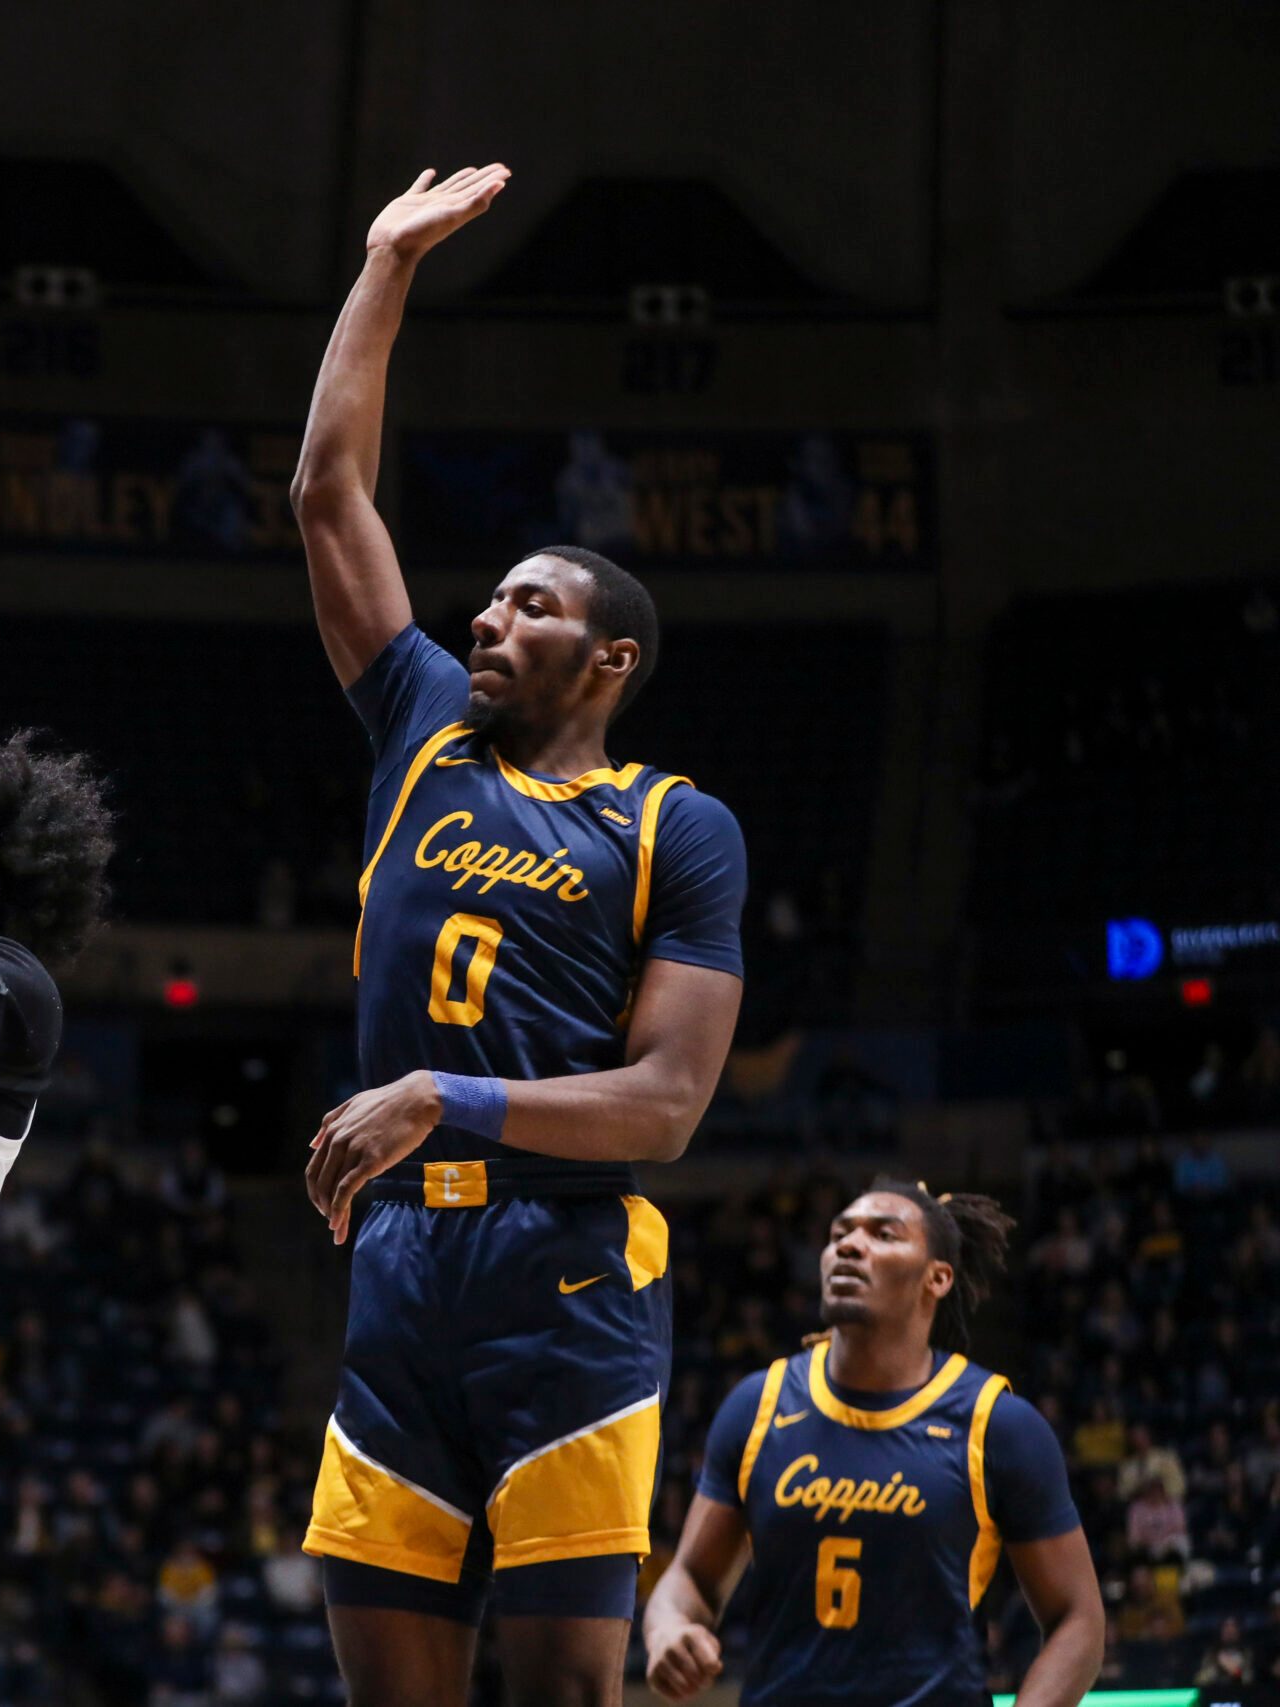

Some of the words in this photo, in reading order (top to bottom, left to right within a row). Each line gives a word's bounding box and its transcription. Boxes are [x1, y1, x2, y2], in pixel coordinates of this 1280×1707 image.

[1, 321, 100, 377] 216
[621, 338, 717, 393] 217
[631, 484, 779, 554] WEST
[853, 488, 919, 555] 44
[414, 811, 589, 902] Coppin
[428, 912, 503, 1028] 0
[443, 1167, 460, 1203] C
[775, 1454, 926, 1523] Coppin
[815, 1536, 863, 1630] 6
